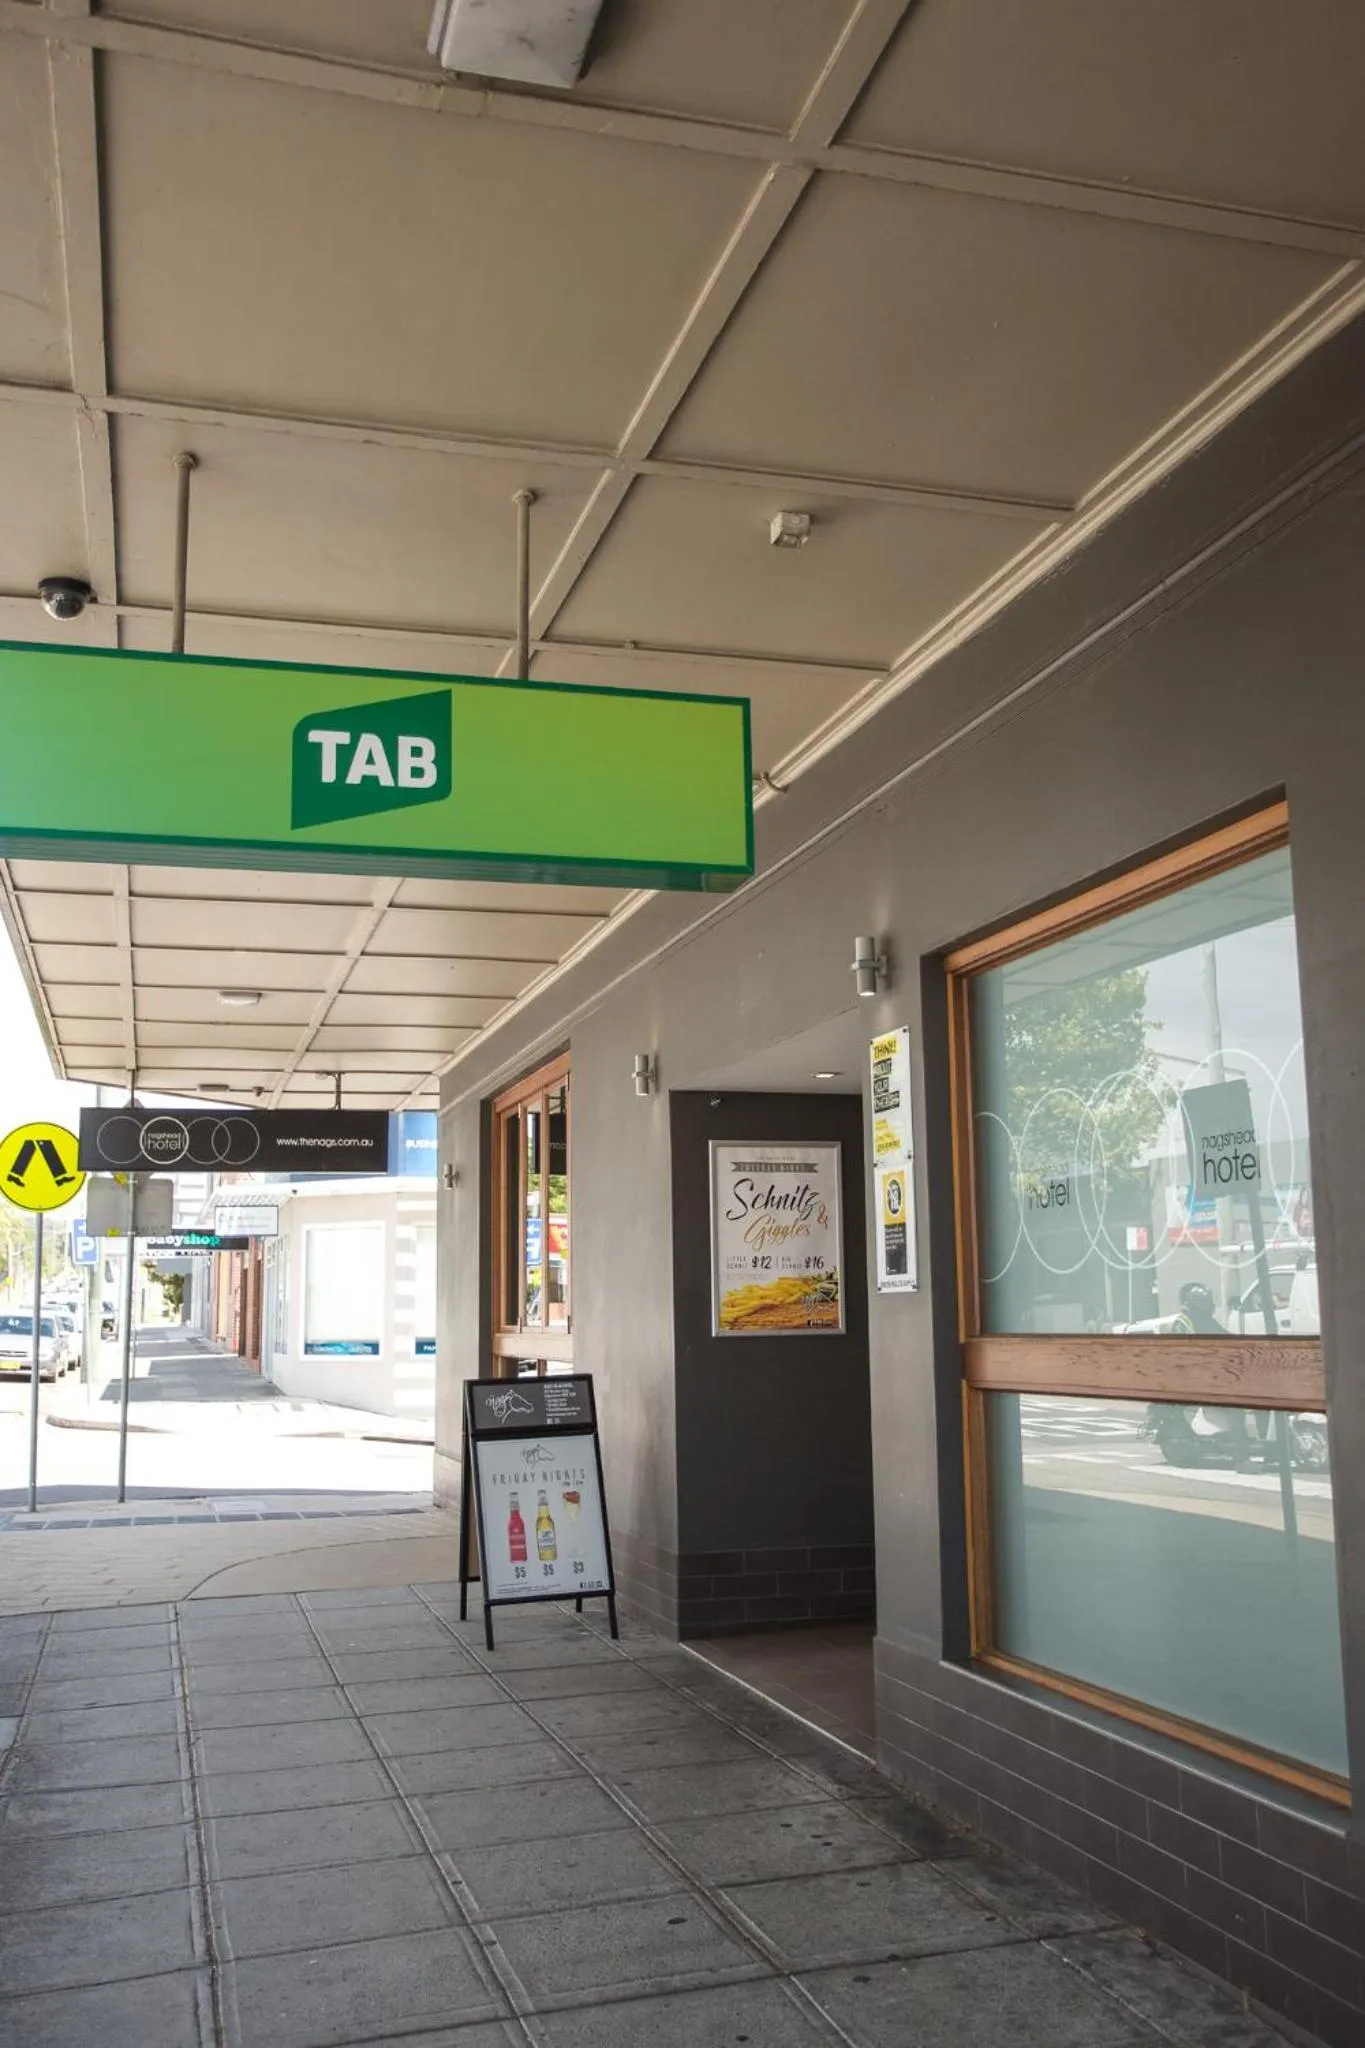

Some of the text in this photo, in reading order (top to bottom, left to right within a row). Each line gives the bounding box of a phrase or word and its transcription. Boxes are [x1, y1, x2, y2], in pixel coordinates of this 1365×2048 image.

[308, 729, 437, 788] TAB
[148, 1139, 180, 1150] hotel
[276, 1137, 373, 1148] www.thenags.com.au
[726, 1178, 820, 1220] Schnitz
[1027, 1177, 1070, 1209] hotel
[744, 1213, 810, 1252] Giggles
[752, 1255, 772, 1269] $12
[805, 1255, 824, 1269] $16
[492, 1467, 585, 1485] FRIDAY NIGHTS
